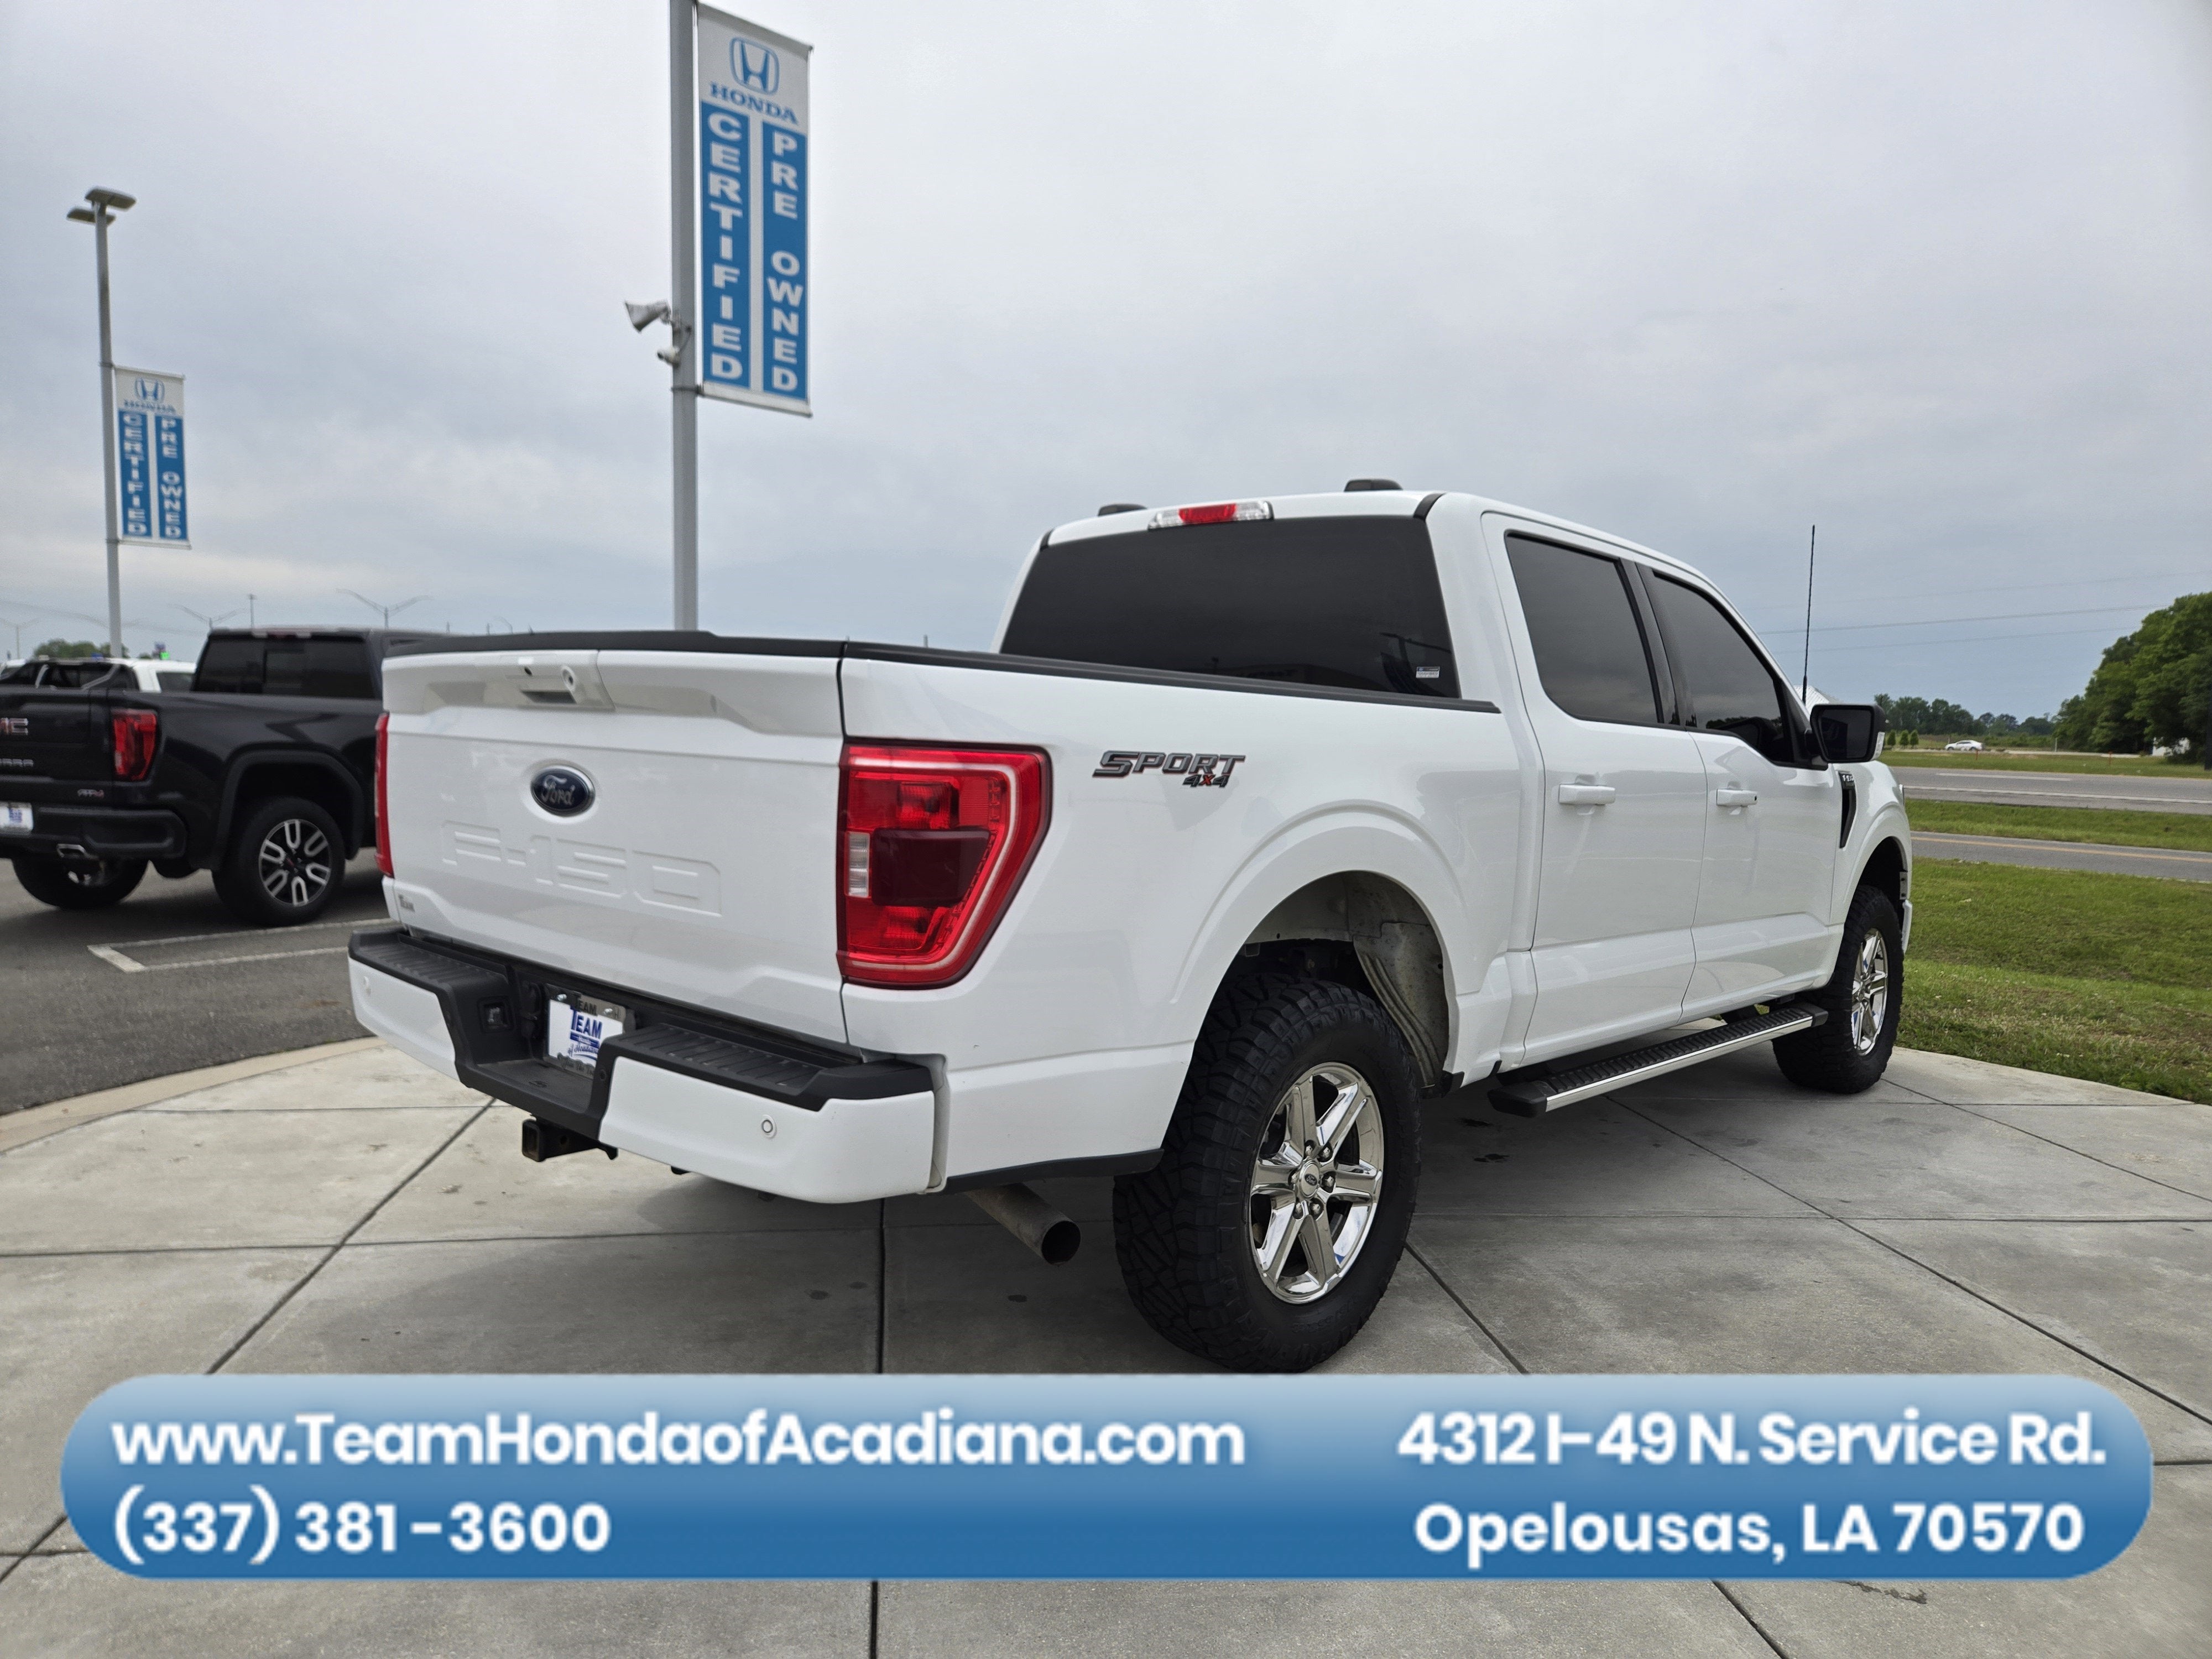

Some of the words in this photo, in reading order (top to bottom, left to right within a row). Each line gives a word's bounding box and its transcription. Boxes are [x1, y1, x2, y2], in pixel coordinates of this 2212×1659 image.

[708, 81, 799, 125] HONDA
[771, 132, 798, 220] PRE
[708, 112, 743, 382] CERTIFIED
[768, 251, 804, 393] OWNED
[123, 413, 147, 535] CERTIFIED
[160, 471, 183, 539] OWNED
[541, 774, 576, 806] Ford
[1092, 750, 1246, 778] SPORT
[570, 1004, 603, 1039] TEAM
